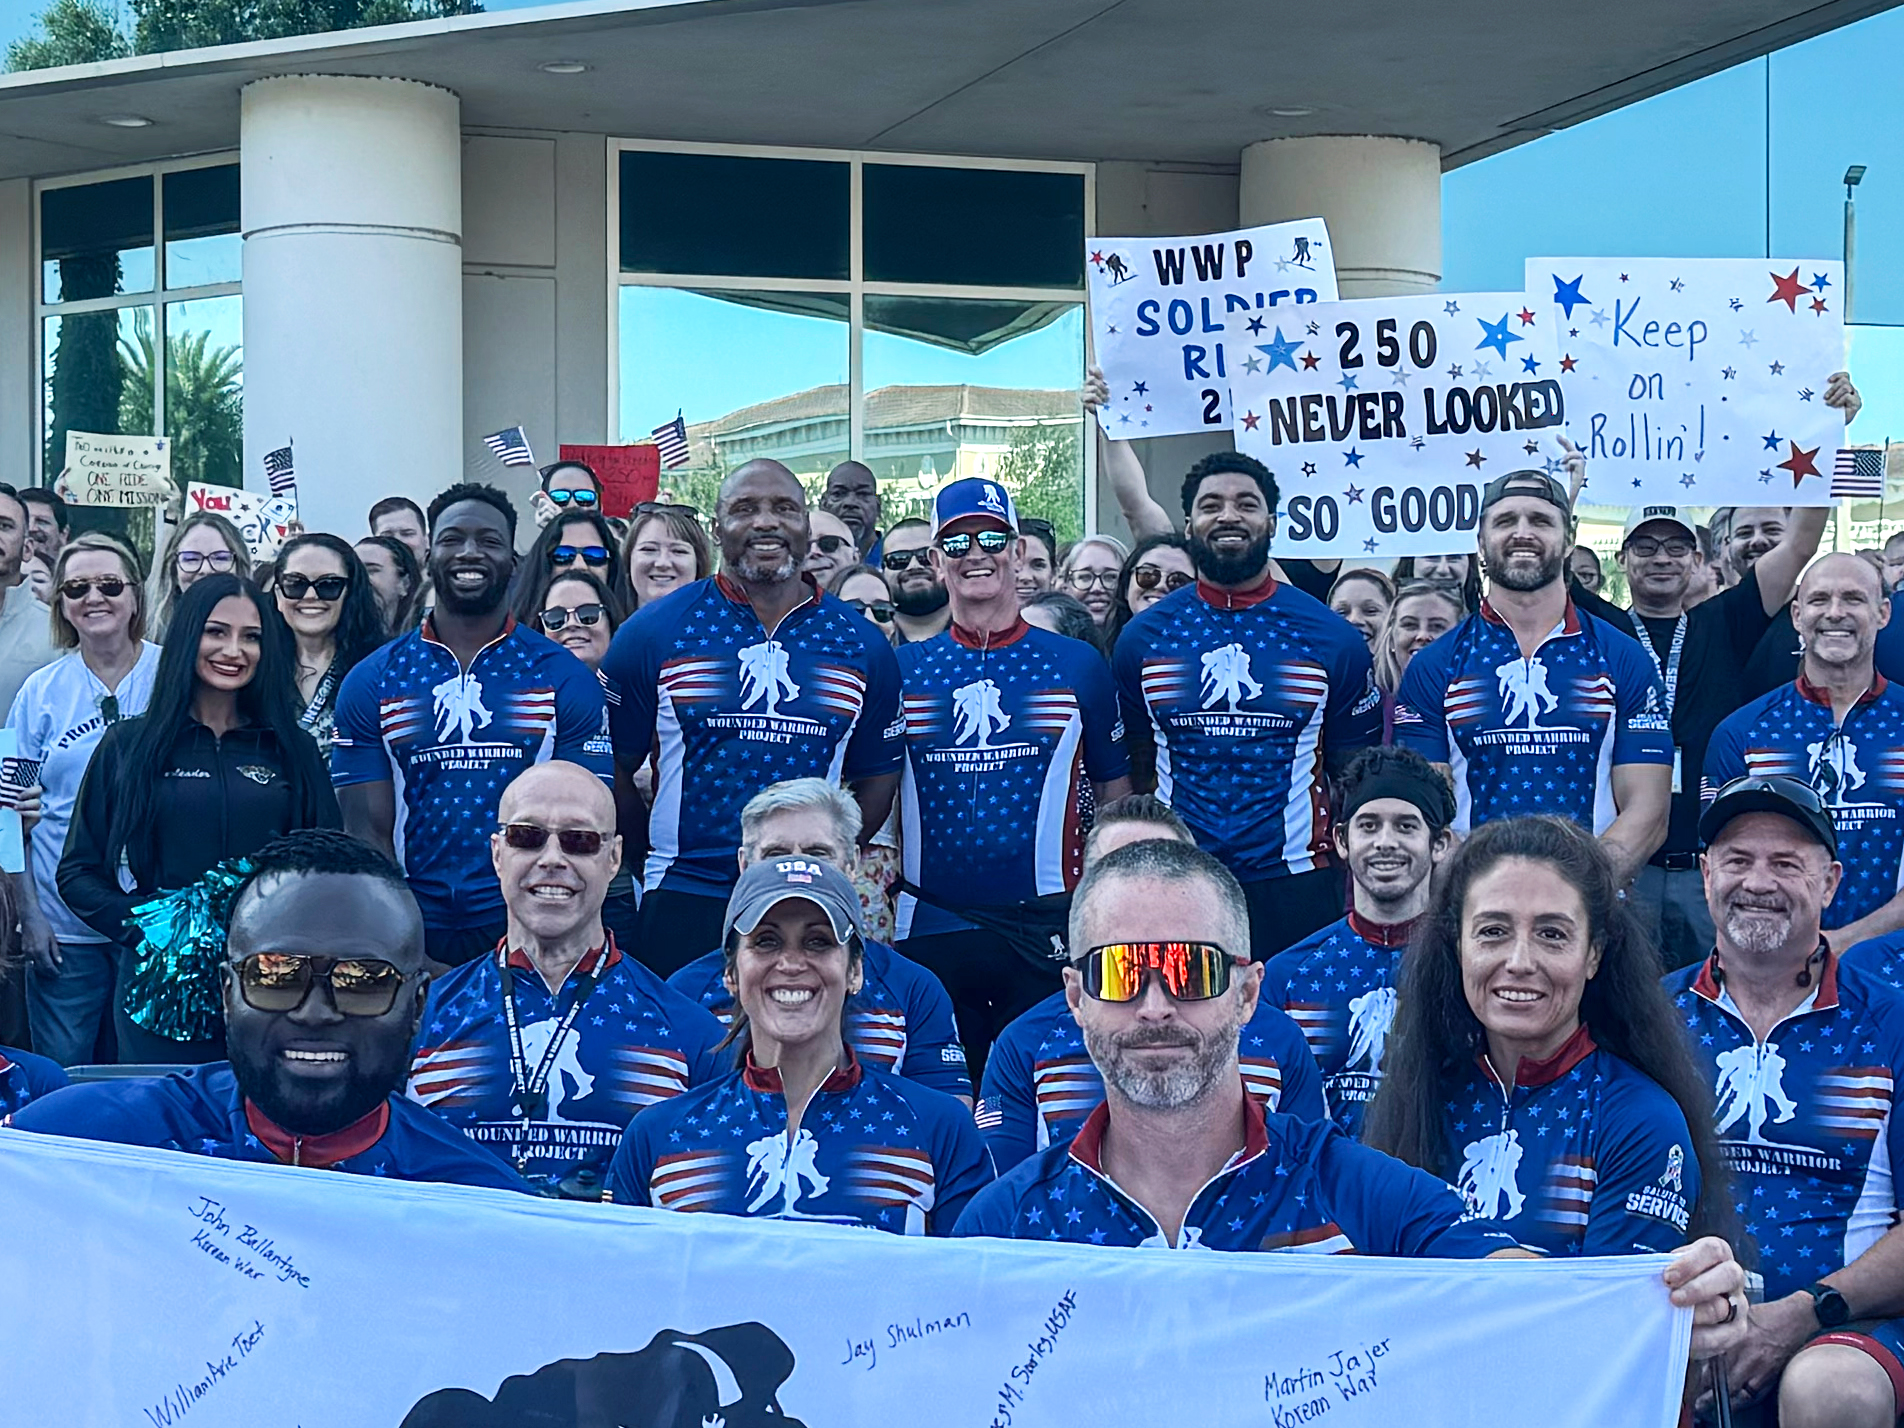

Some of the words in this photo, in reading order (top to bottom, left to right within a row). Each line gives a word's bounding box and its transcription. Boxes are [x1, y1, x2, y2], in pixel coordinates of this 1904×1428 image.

[1153, 239, 1253, 286] WWP
[1335, 319, 1438, 370] 250
[1612, 296, 1710, 353] Keep
[1627, 369, 1666, 402] on
[1269, 388, 1406, 447] NEVER
[1424, 378, 1565, 439] LOOKED
[1287, 493, 1339, 543] SO
[776, 860, 823, 876] USA
[187, 1195, 230, 1237] John
[841, 1338, 876, 1371] Jay
[886, 1311, 971, 1349] Shulman
